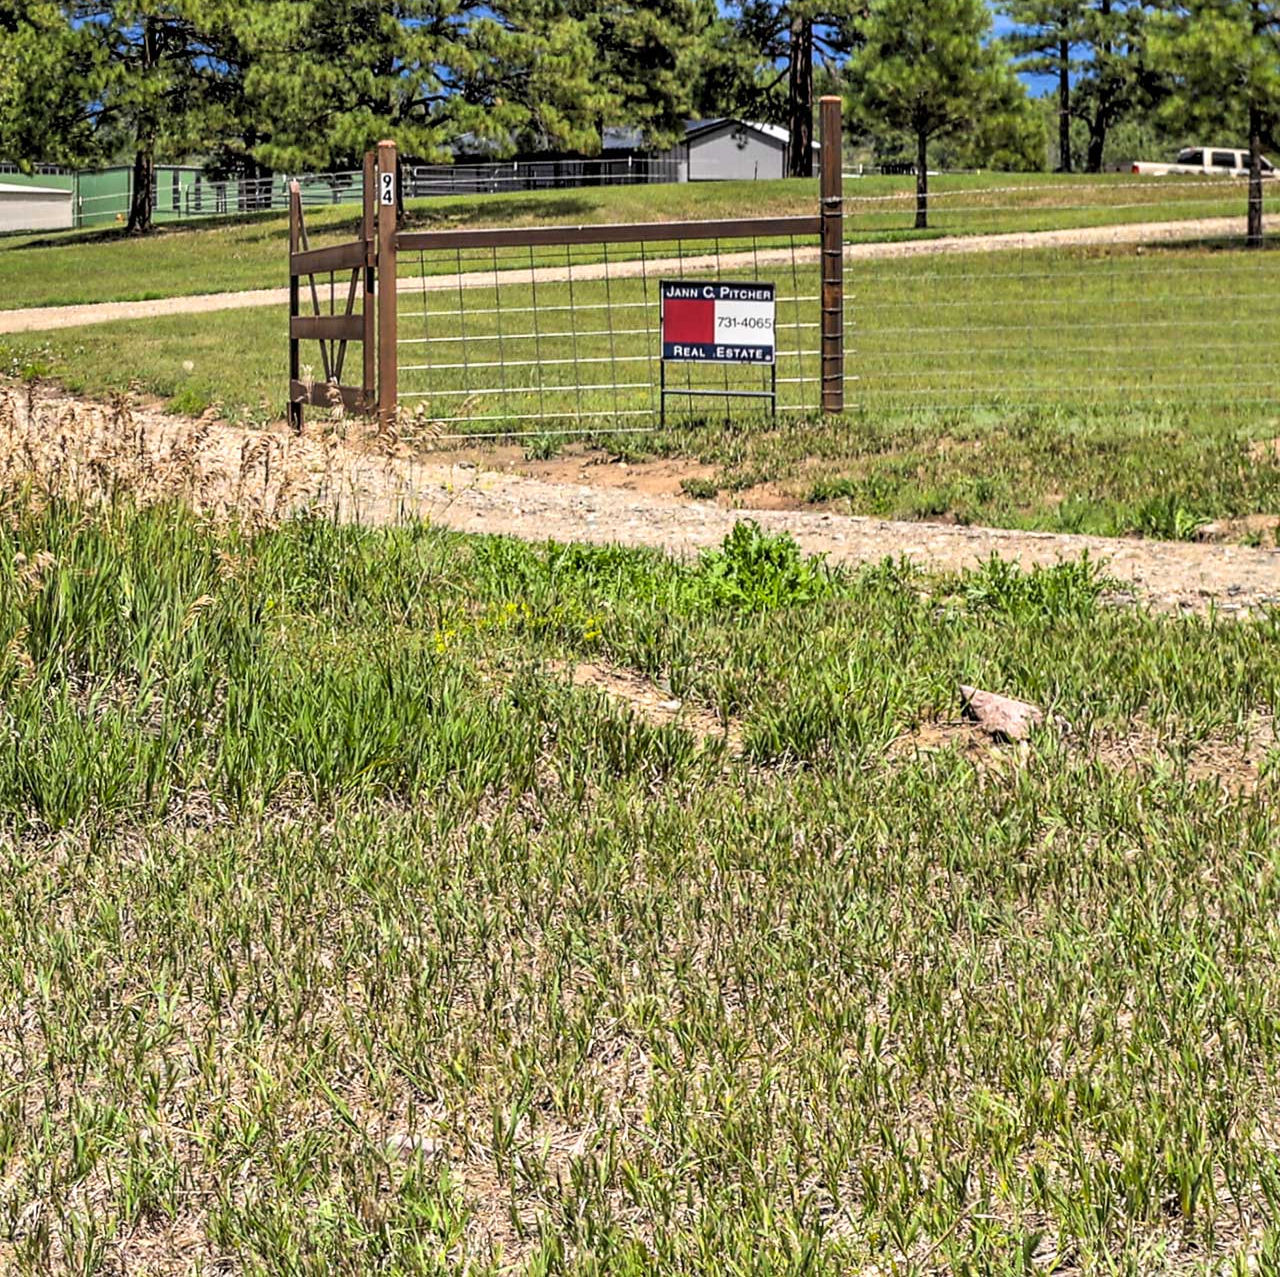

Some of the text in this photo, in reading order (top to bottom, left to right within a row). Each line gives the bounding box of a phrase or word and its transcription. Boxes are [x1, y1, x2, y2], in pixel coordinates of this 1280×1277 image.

[666, 286, 698, 297] JANN
[720, 286, 771, 299] PITCHER
[717, 317, 772, 329] 731-4065
[673, 345, 763, 359] REAL ESTATE
